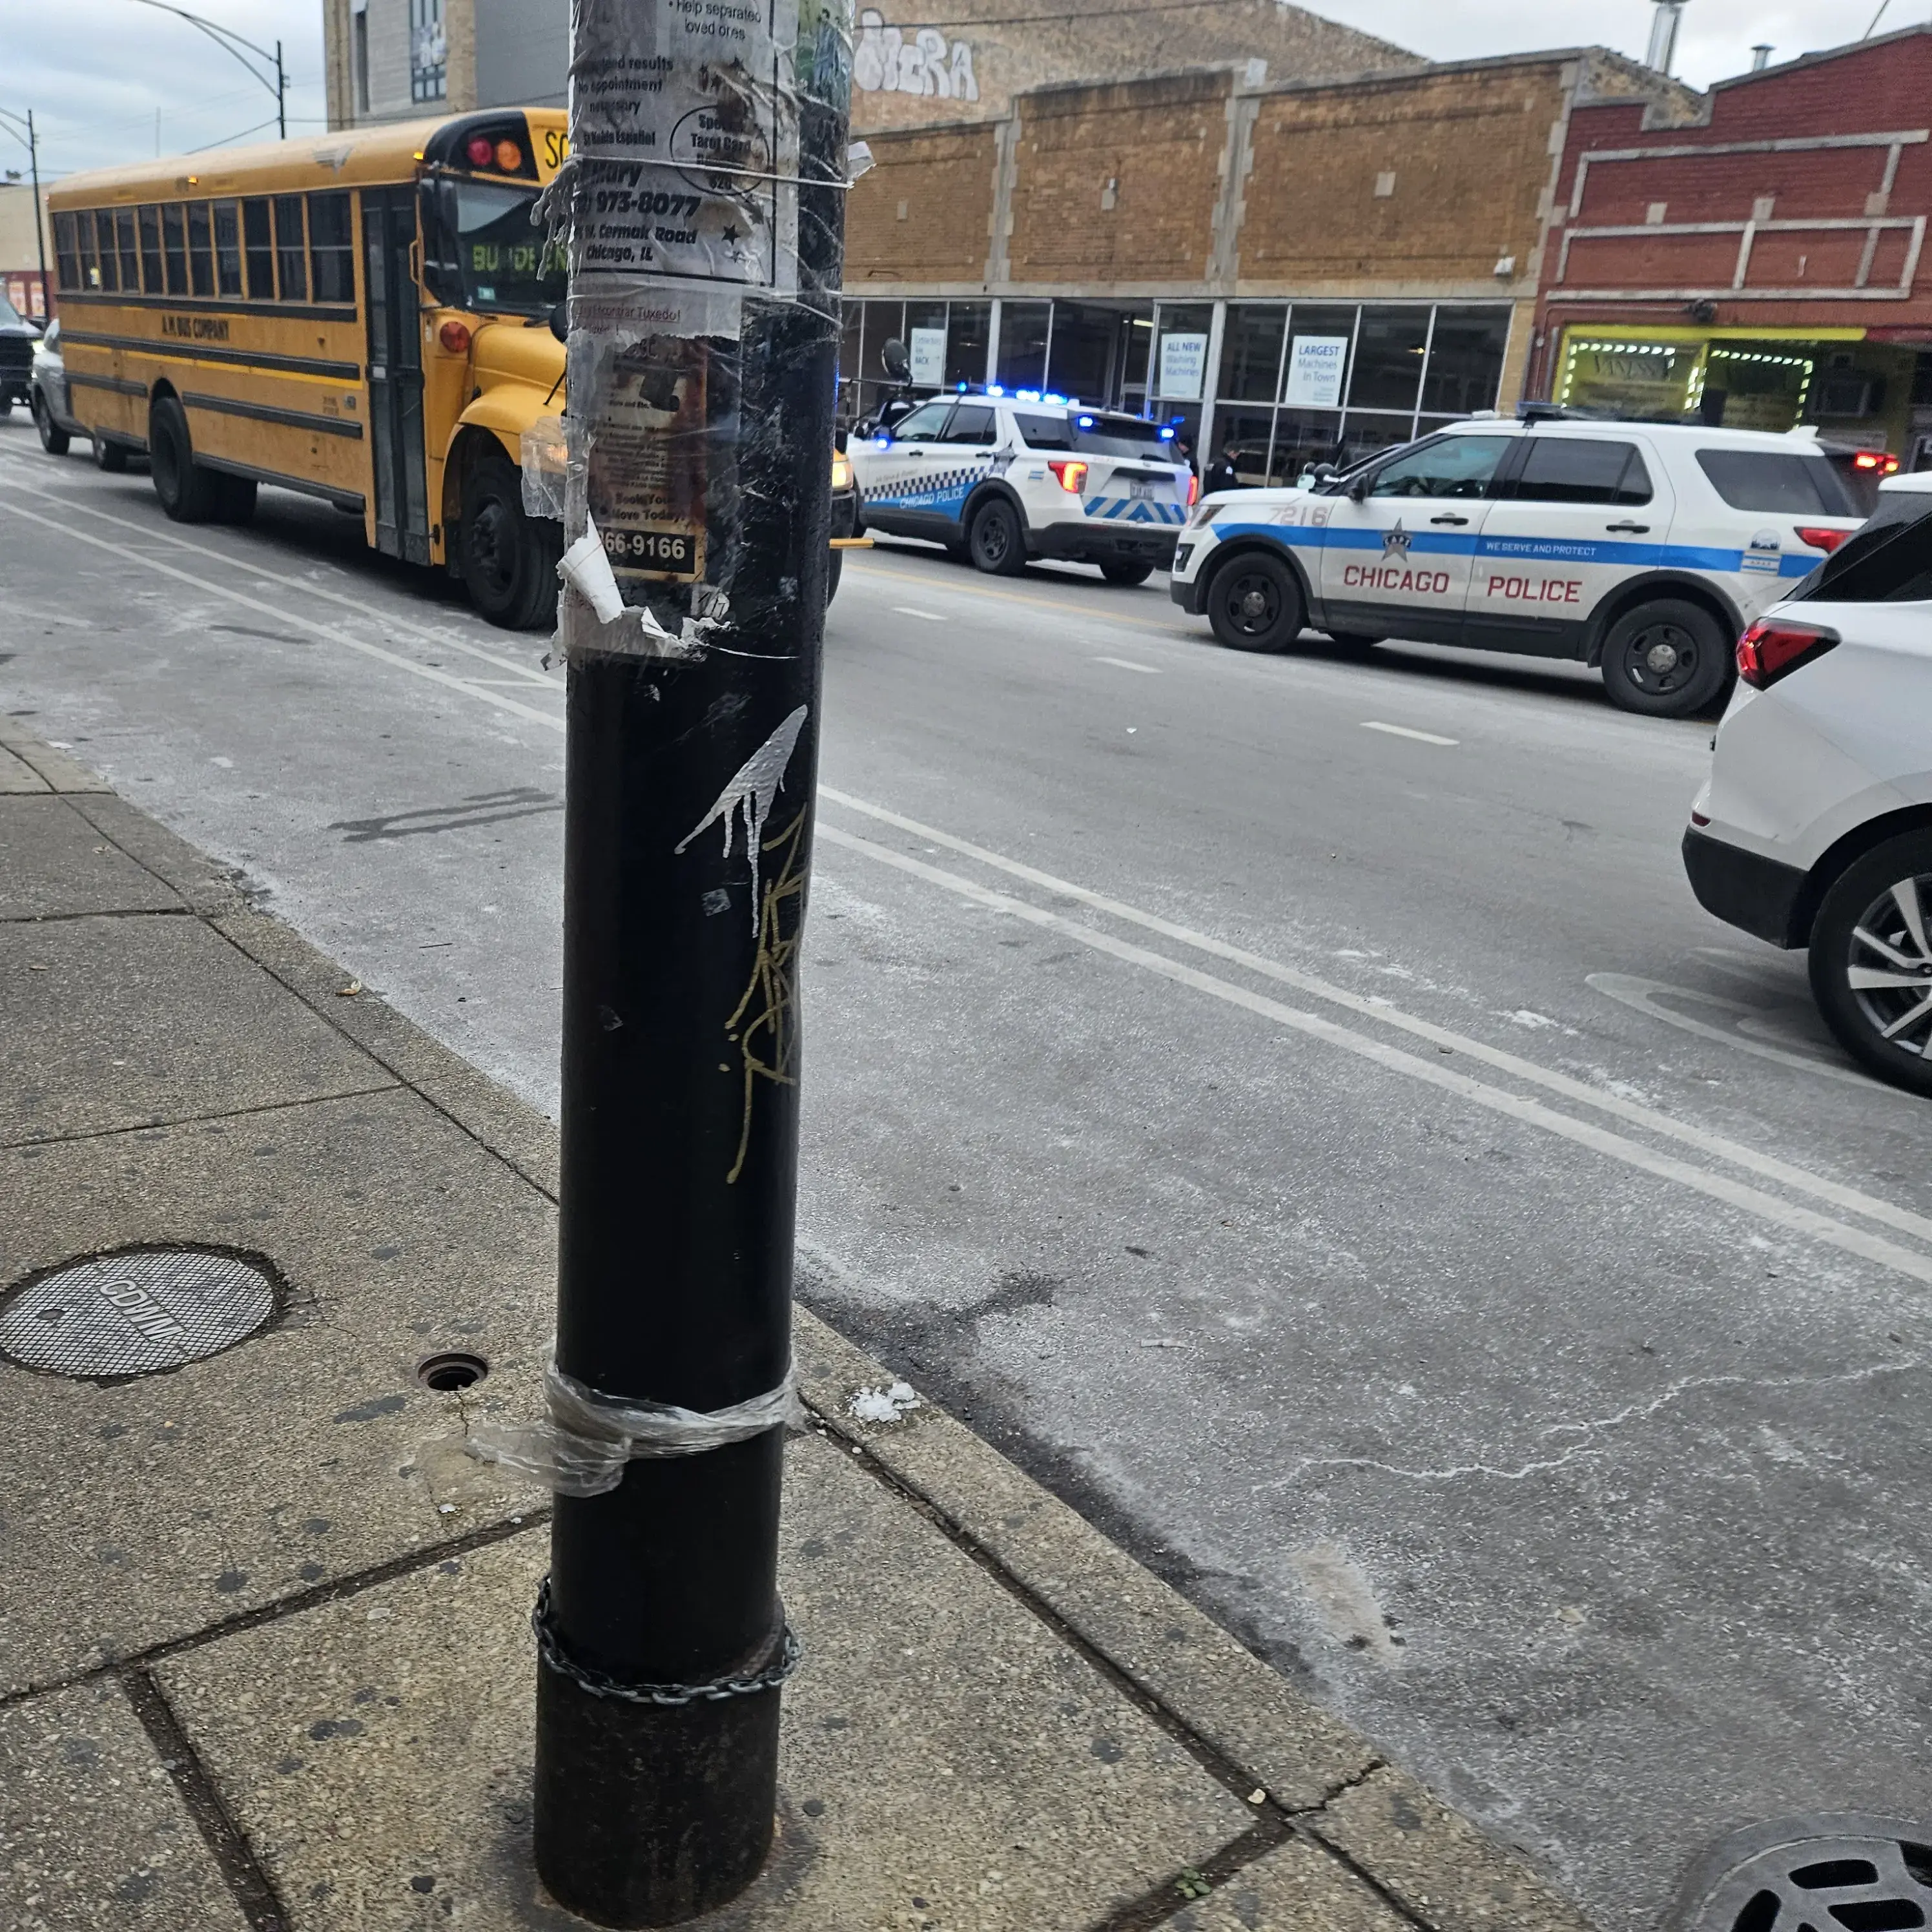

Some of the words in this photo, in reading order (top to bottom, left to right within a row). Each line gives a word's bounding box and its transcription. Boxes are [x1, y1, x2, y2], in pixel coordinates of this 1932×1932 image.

[677, 1, 702, 14] Help
[706, 3, 762, 23] separated
[685, 19, 715, 35] loved
[629, 56, 673, 71] results
[597, 190, 702, 217] 973-8077
[655, 226, 699, 244] Road
[640, 245, 653, 261] IL
[1167, 342, 1180, 352] ALL
[1182, 342, 1201, 353] NEW
[1299, 345, 1340, 356] LARGEST
[1166, 366, 1199, 376] Machines
[1298, 358, 1337, 370] Machines
[1313, 371, 1336, 383] Town
[899, 495, 935, 509] CHICAGO
[936, 486, 965, 504] POLICE
[1267, 506, 1328, 527] 7216
[1487, 542, 1500, 551] WE
[1502, 542, 1532, 553] SERVE
[1532, 544, 1551, 554] AND
[1552, 545, 1597, 556] PROTECT
[1344, 565, 1450, 593] CHICAGO
[1487, 576, 1583, 602] POLICE
